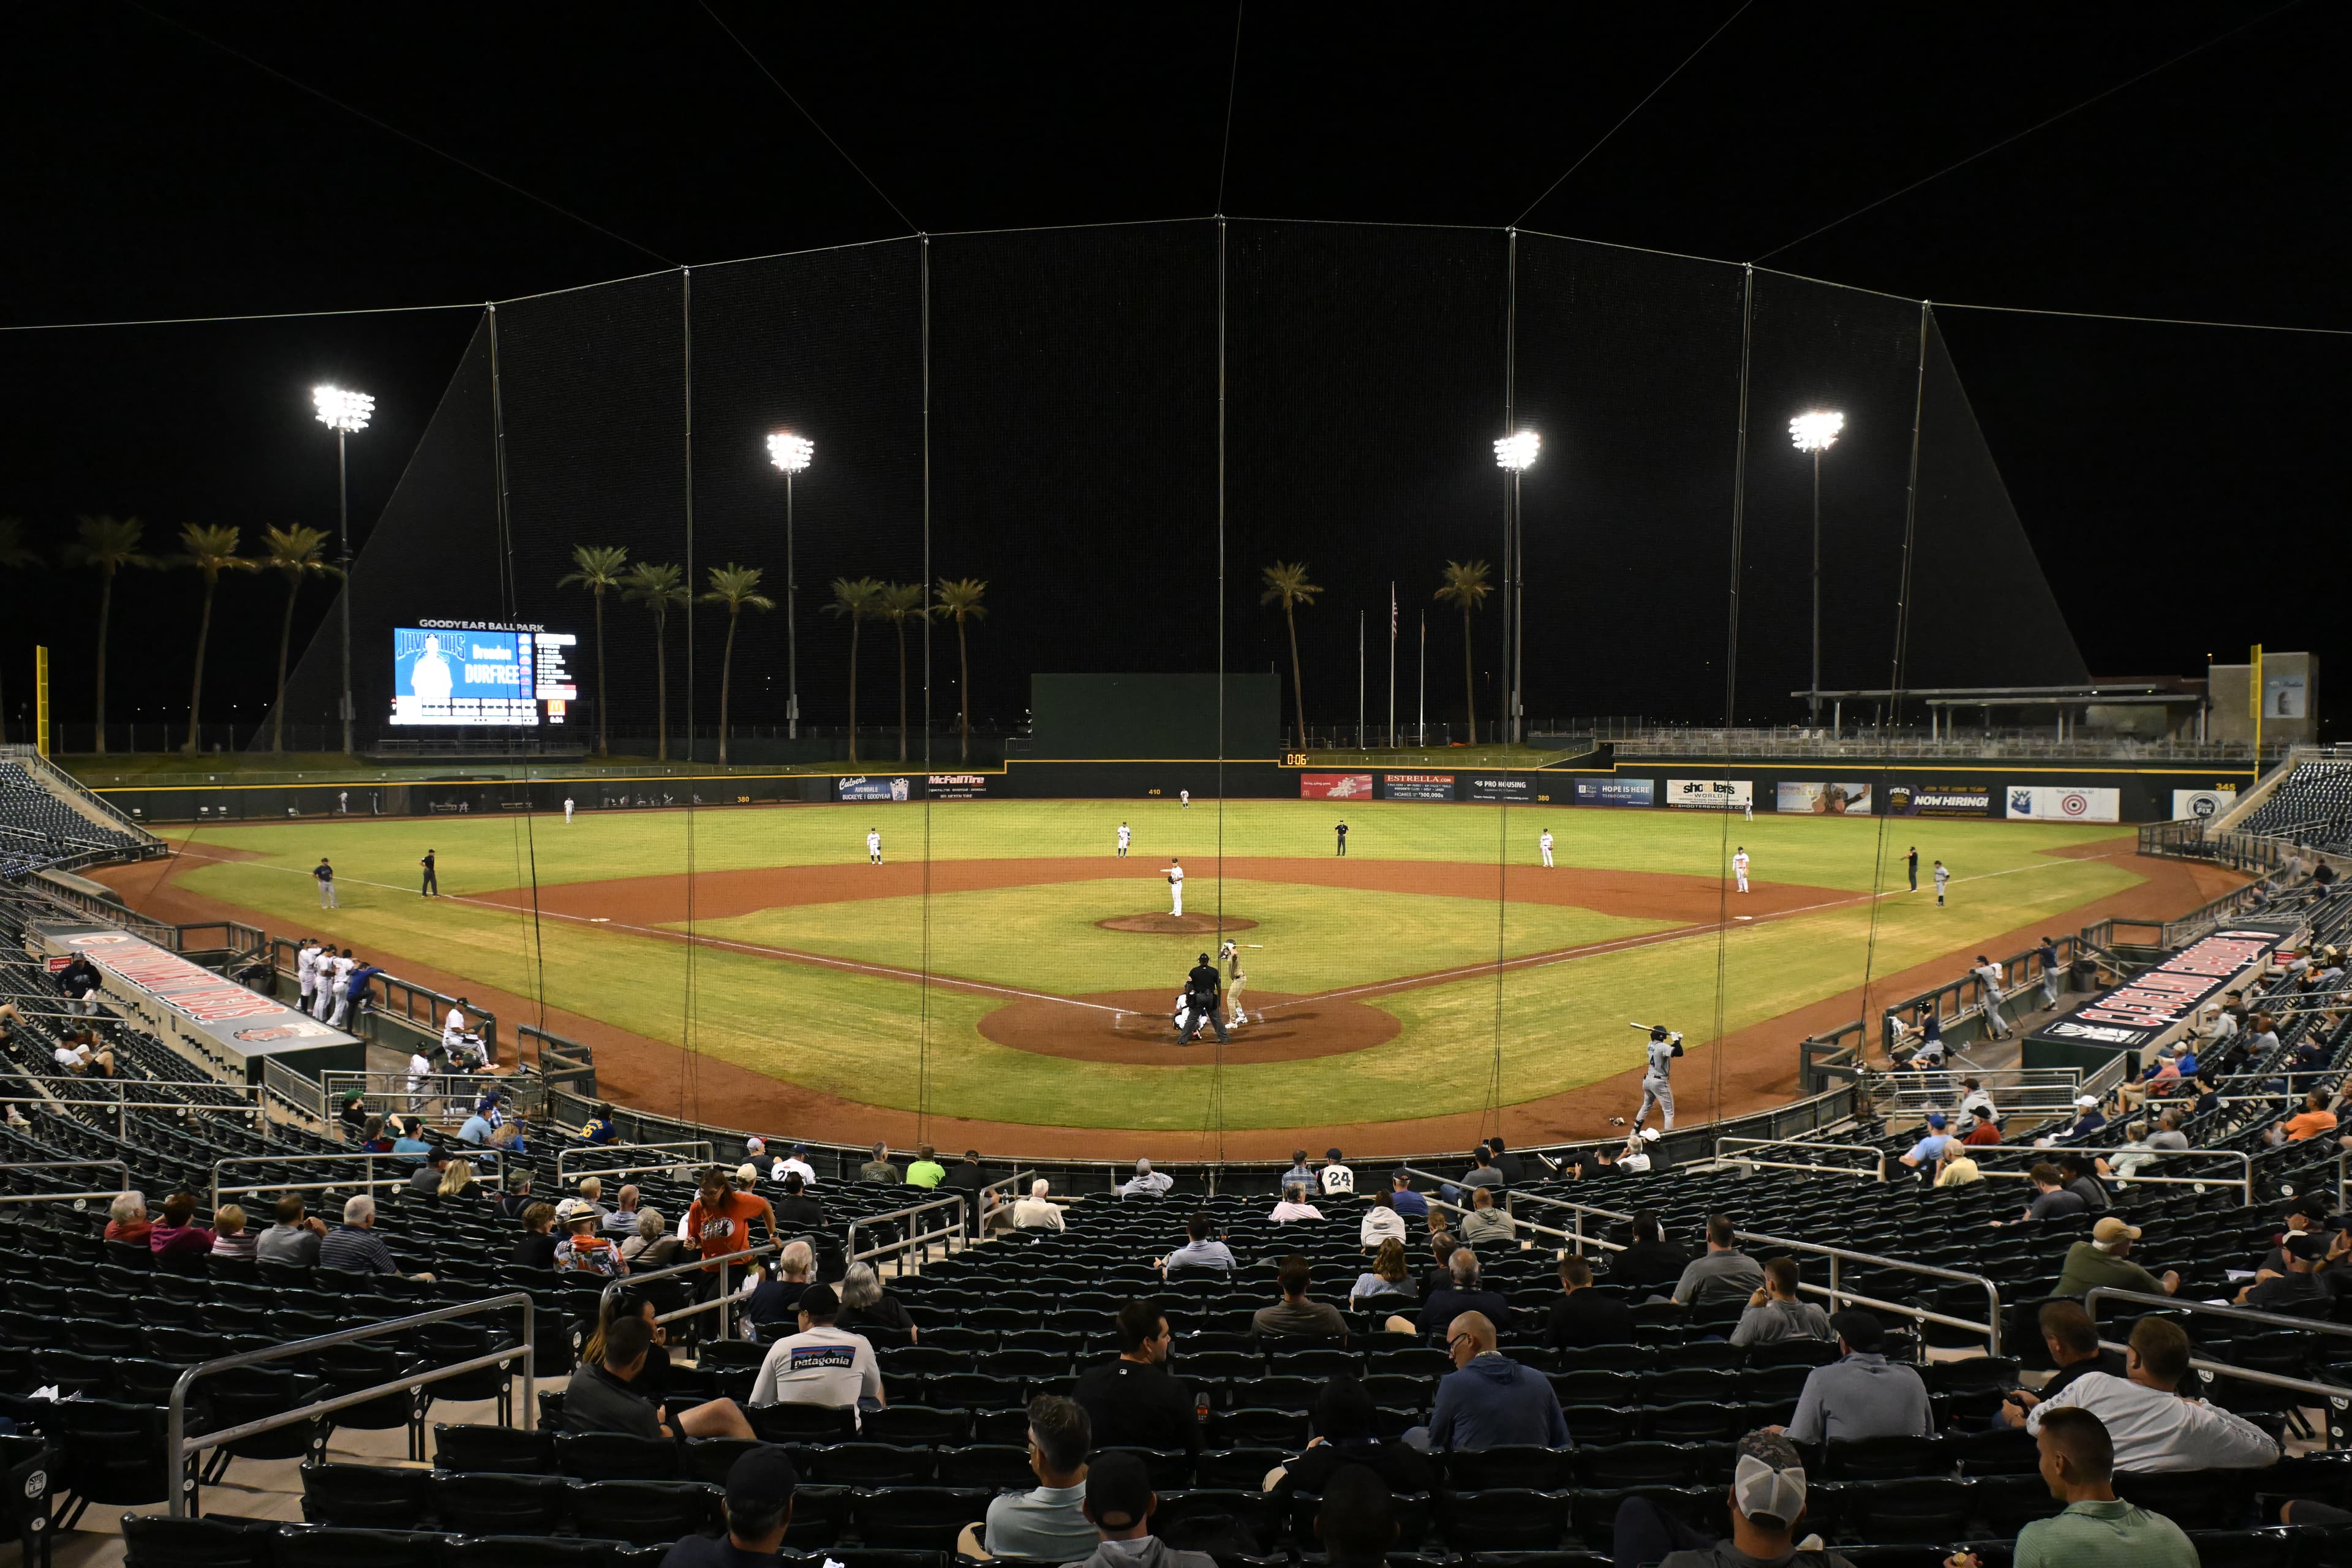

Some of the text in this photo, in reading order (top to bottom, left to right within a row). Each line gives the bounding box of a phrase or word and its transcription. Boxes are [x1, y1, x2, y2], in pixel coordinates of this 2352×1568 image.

[419, 619, 486, 630] GOODYEAR
[1287, 754, 1306, 765] 0:06
[929, 775, 984, 784] McFallTire
[2215, 783, 2236, 791] 345
[1914, 796, 1989, 807] NOW HIRING!
[154, 987, 288, 1022] REDS
[1329, 1172, 1351, 1186] 24
[794, 1356, 850, 1369] patagonia
